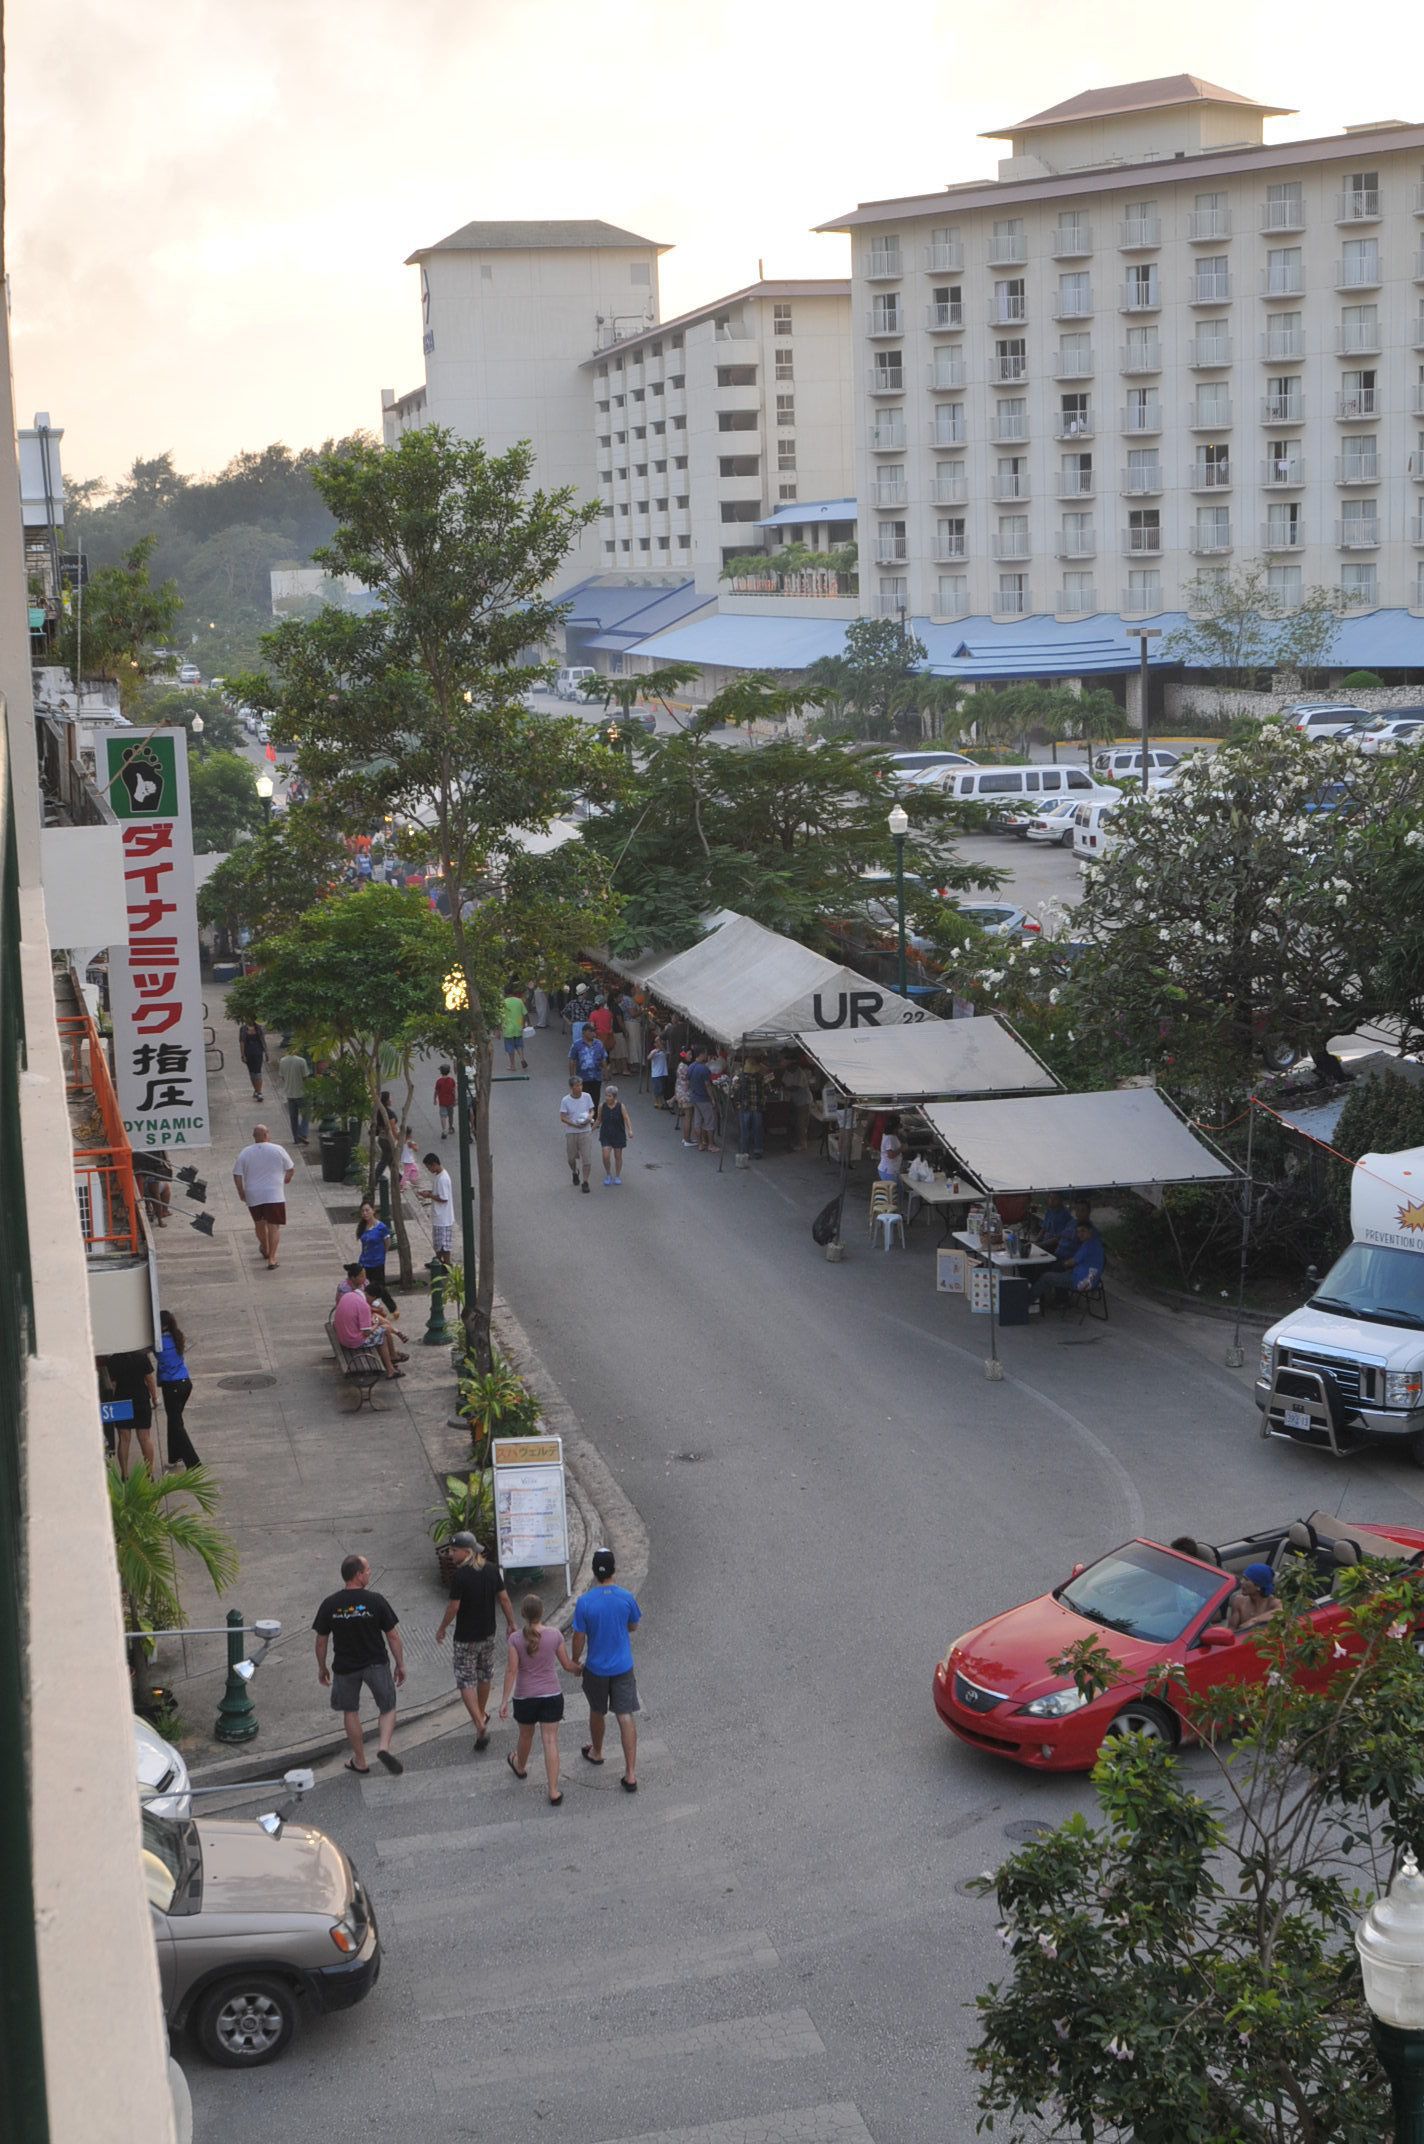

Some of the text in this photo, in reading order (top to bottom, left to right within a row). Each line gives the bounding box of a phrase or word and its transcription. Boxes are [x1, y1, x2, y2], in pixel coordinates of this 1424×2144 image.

[122, 823, 183, 1035] ダイナミック
[813, 991, 925, 1029] UR 22
[132, 1043, 194, 1112] 指圧
[122, 1117, 204, 1132] DYNAMIC
[146, 1131, 186, 1145] SPA
[1365, 1228, 1415, 1248] PREVENTION
[102, 1405, 114, 1420] St
